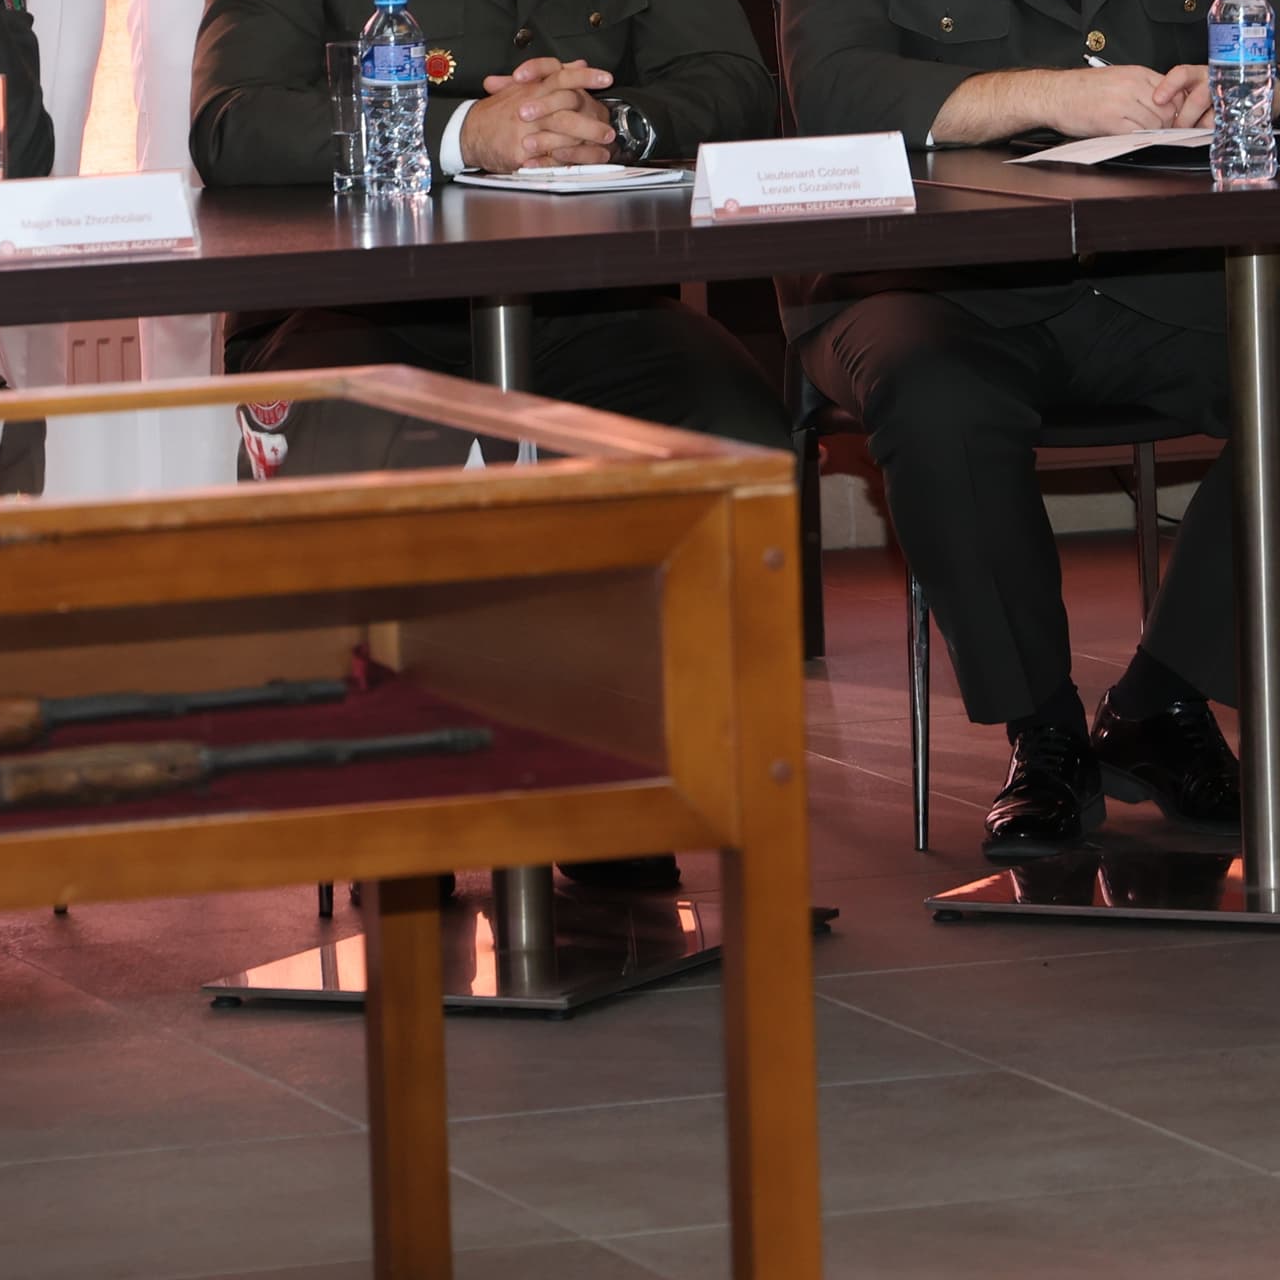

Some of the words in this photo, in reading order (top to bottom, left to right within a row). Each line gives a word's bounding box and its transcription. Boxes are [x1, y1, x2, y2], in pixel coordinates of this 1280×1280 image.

[757, 168, 815, 182] Lieutenant
[817, 166, 860, 178] Colonel
[762, 183, 796, 195] Levan
[758, 203, 805, 215] NATIONAL
[806, 201, 850, 213] DEFENCE
[851, 198, 897, 209] ACADEMY
[32, 244, 83, 257] NATIONAL
[131, 238, 179, 251] ACADEMY
